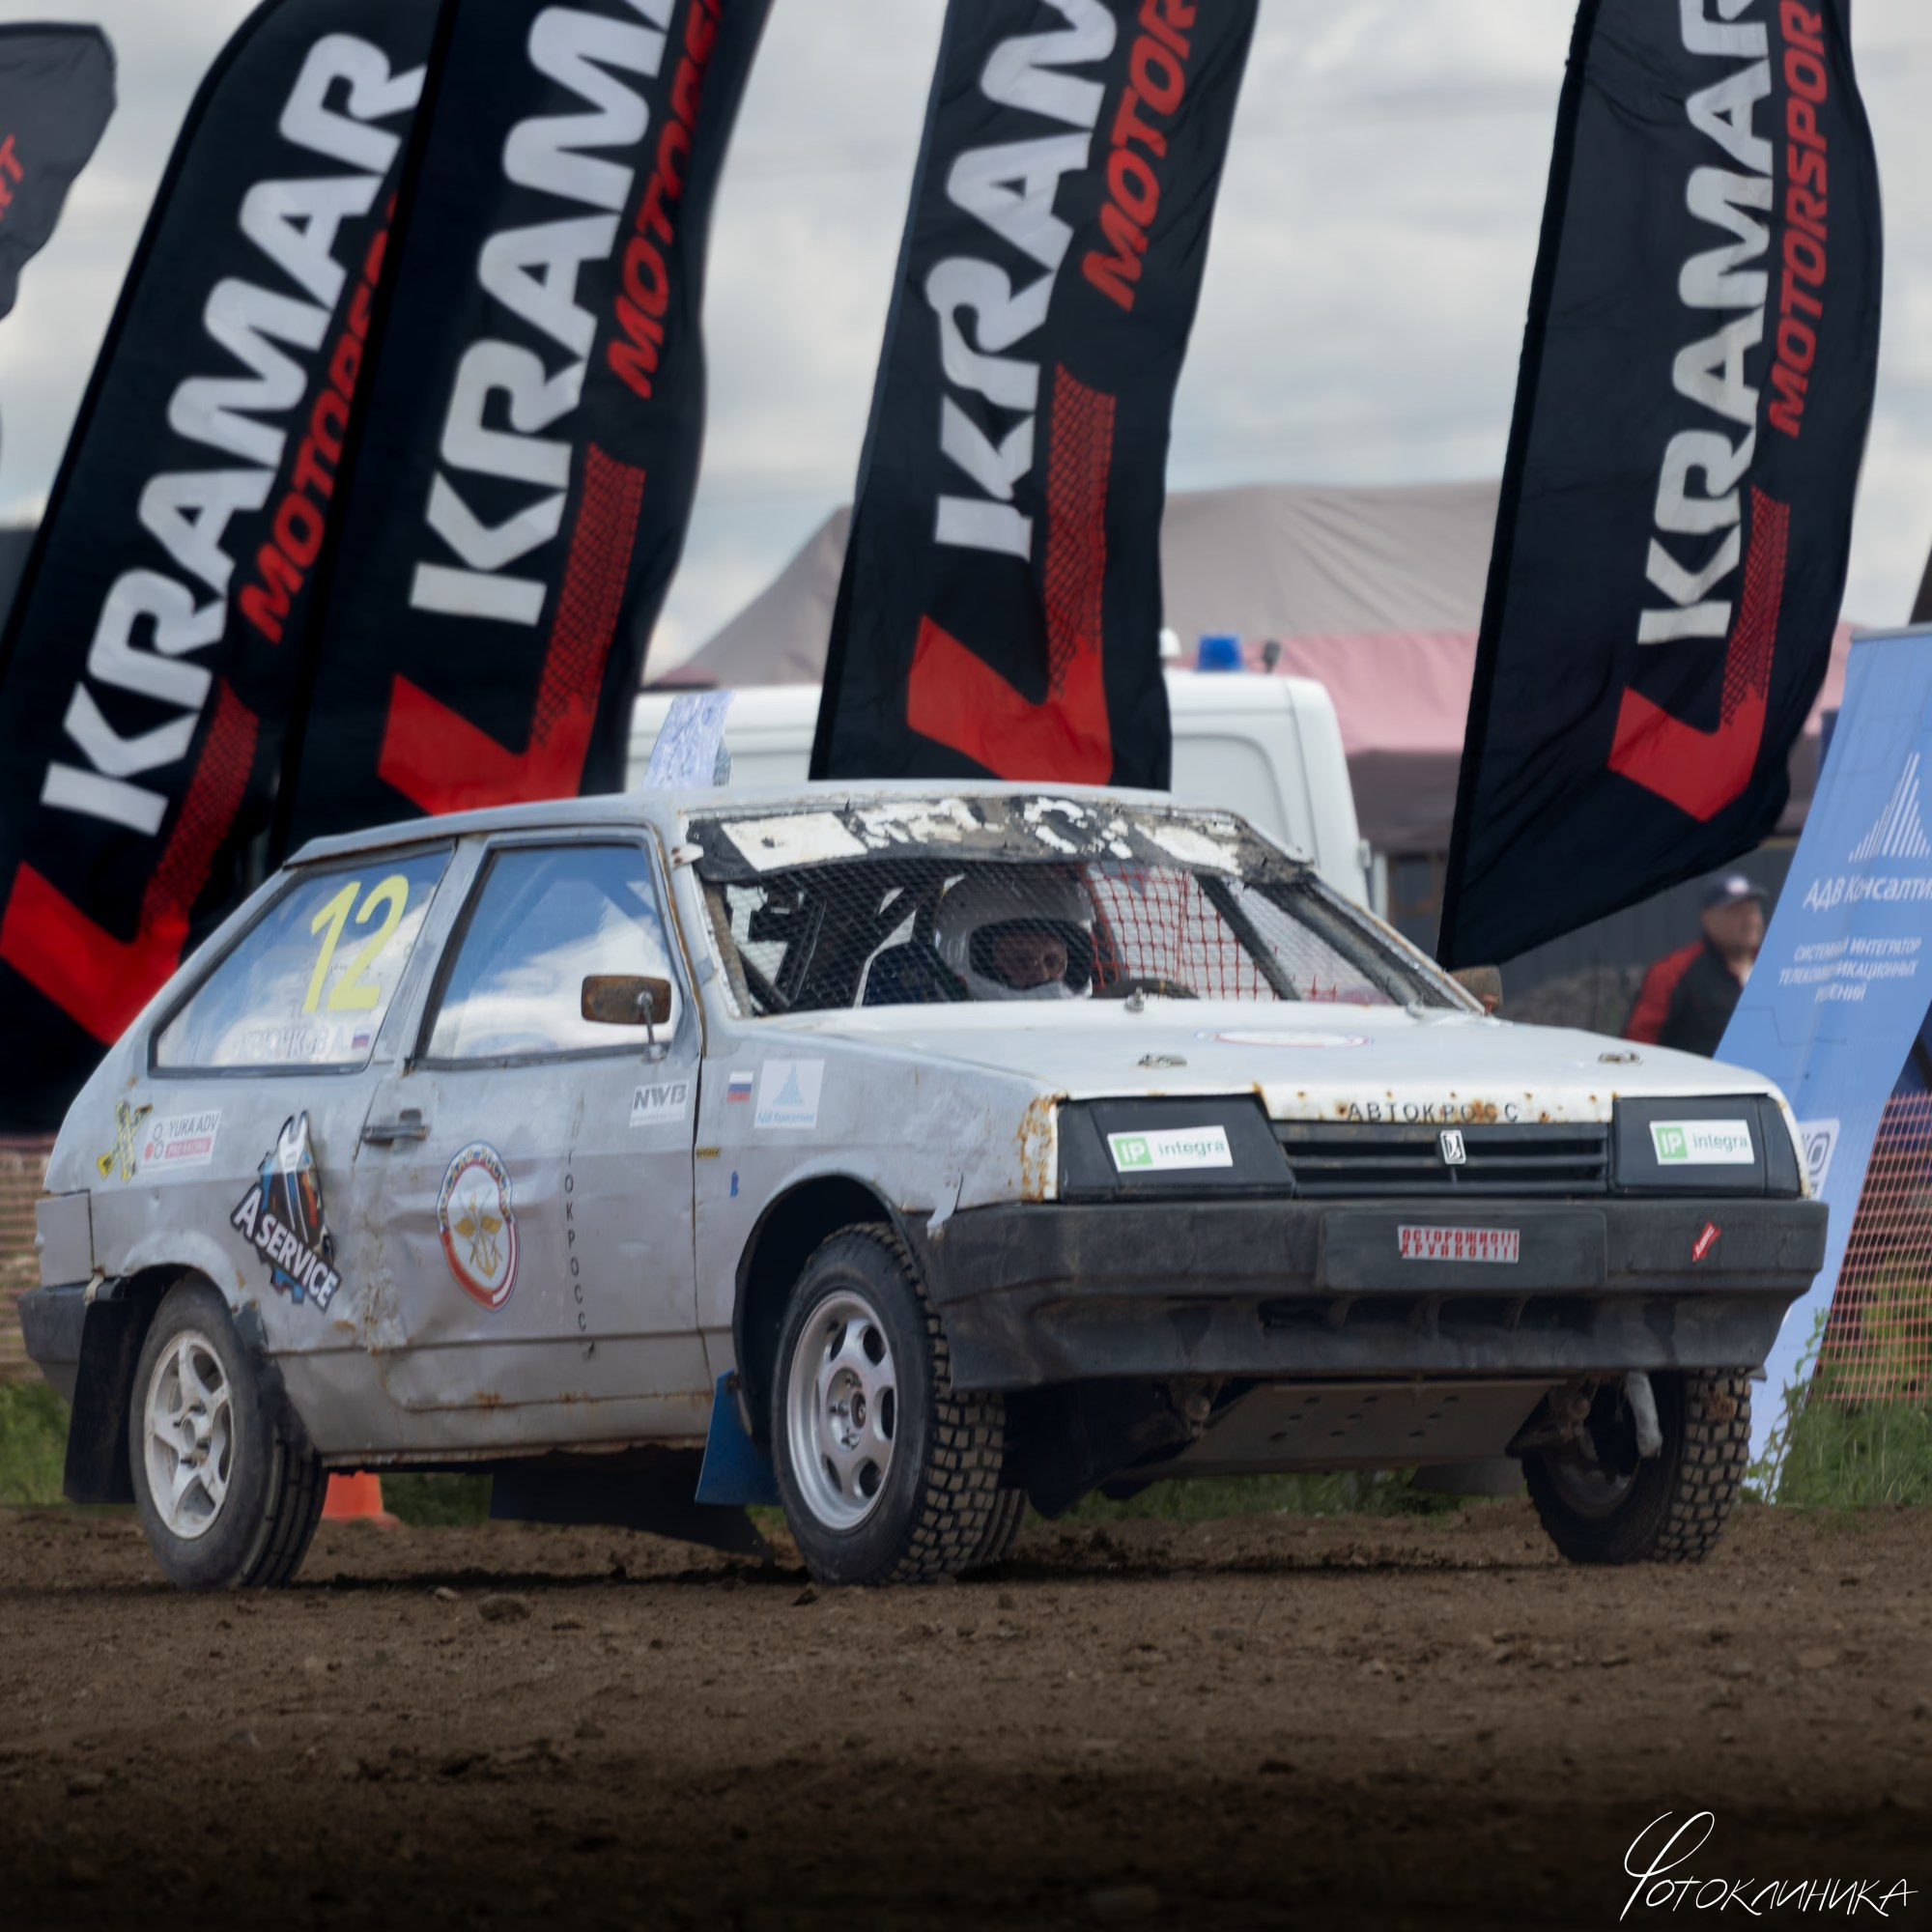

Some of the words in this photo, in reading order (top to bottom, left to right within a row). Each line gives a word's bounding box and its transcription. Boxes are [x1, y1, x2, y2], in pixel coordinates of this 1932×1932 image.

[1769, 0, 1828, 440] MOTORSPOR
[410, 0, 674, 626] KRAM
[41, 33, 428, 838] KRAMAR
[1803, 875, 1845, 912] АДВ
[303, 873, 410, 1012] 12
[169, 1119, 195, 1139] YUKA
[195, 1114, 220, 1134] ADV
[633, 1084, 688, 1110] NWB
[1347, 1102, 1519, 1122] АВТОКРОСС
[1692, 1133, 1747, 1152] integra
[233, 1186, 263, 1240] A
[255, 1212, 338, 1308] SERVICE
